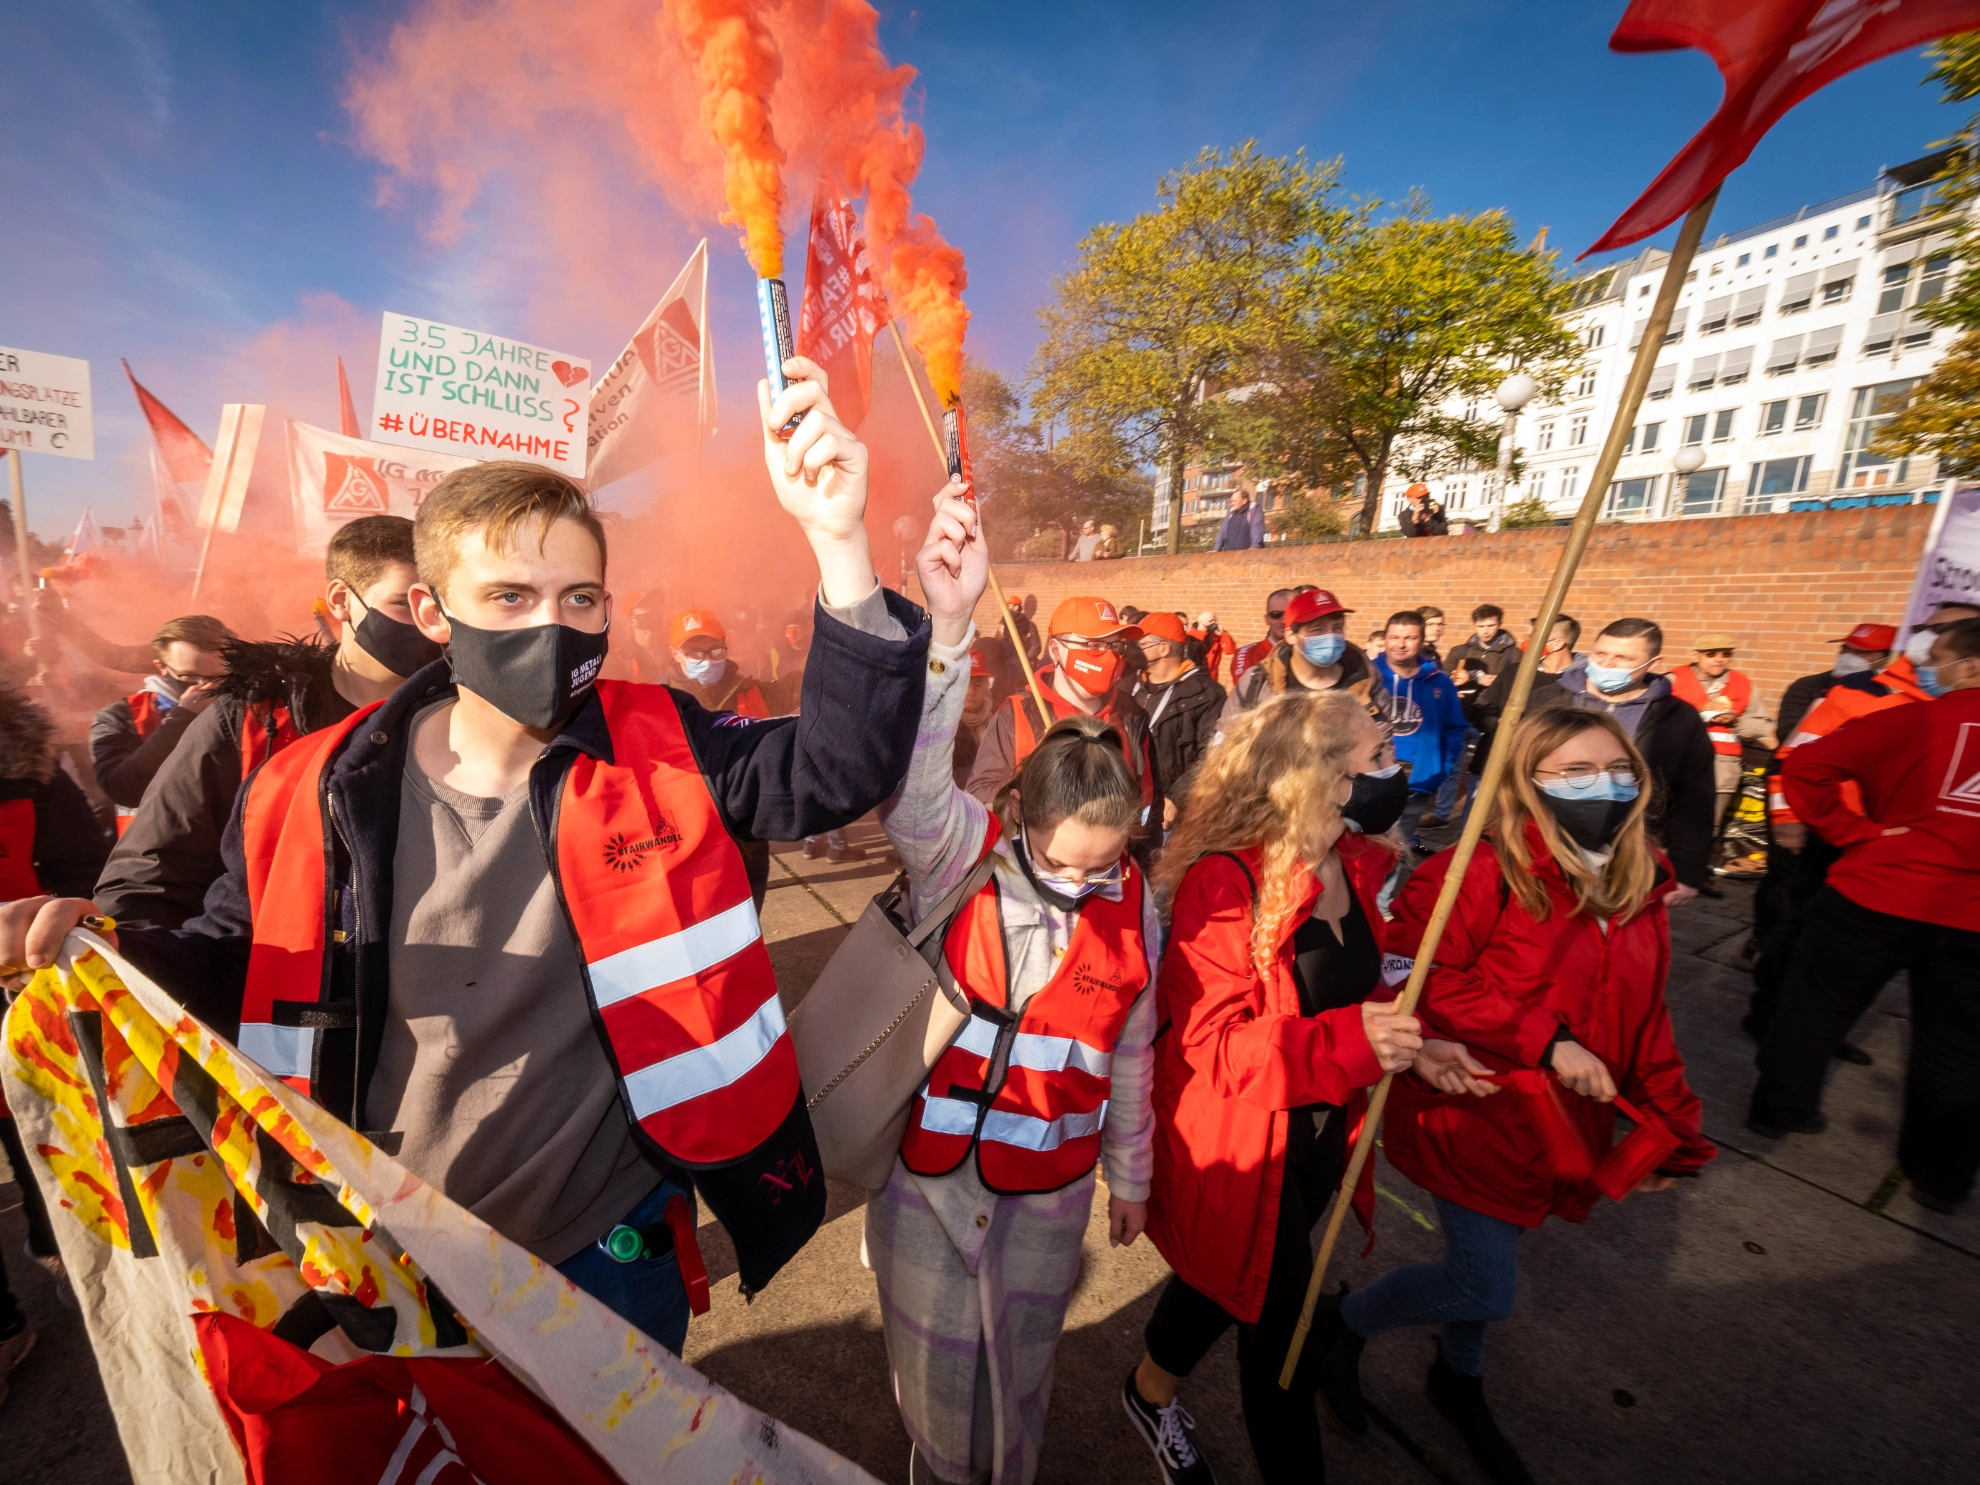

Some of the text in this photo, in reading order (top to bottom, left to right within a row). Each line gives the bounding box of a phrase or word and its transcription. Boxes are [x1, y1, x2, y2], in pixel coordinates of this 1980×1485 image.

[389, 347, 540, 394] UND DANN
[460, 332, 550, 372] JAHRE
[384, 370, 580, 433] IST SCHLUSS ?
[588, 382, 632, 427] iven
[378, 412, 570, 461] #ÜBERNAHME
[571, 668, 579, 679] IG
[571, 667, 597, 688] JUGEND
[618, 833, 683, 857] #FAIRWANDEL
